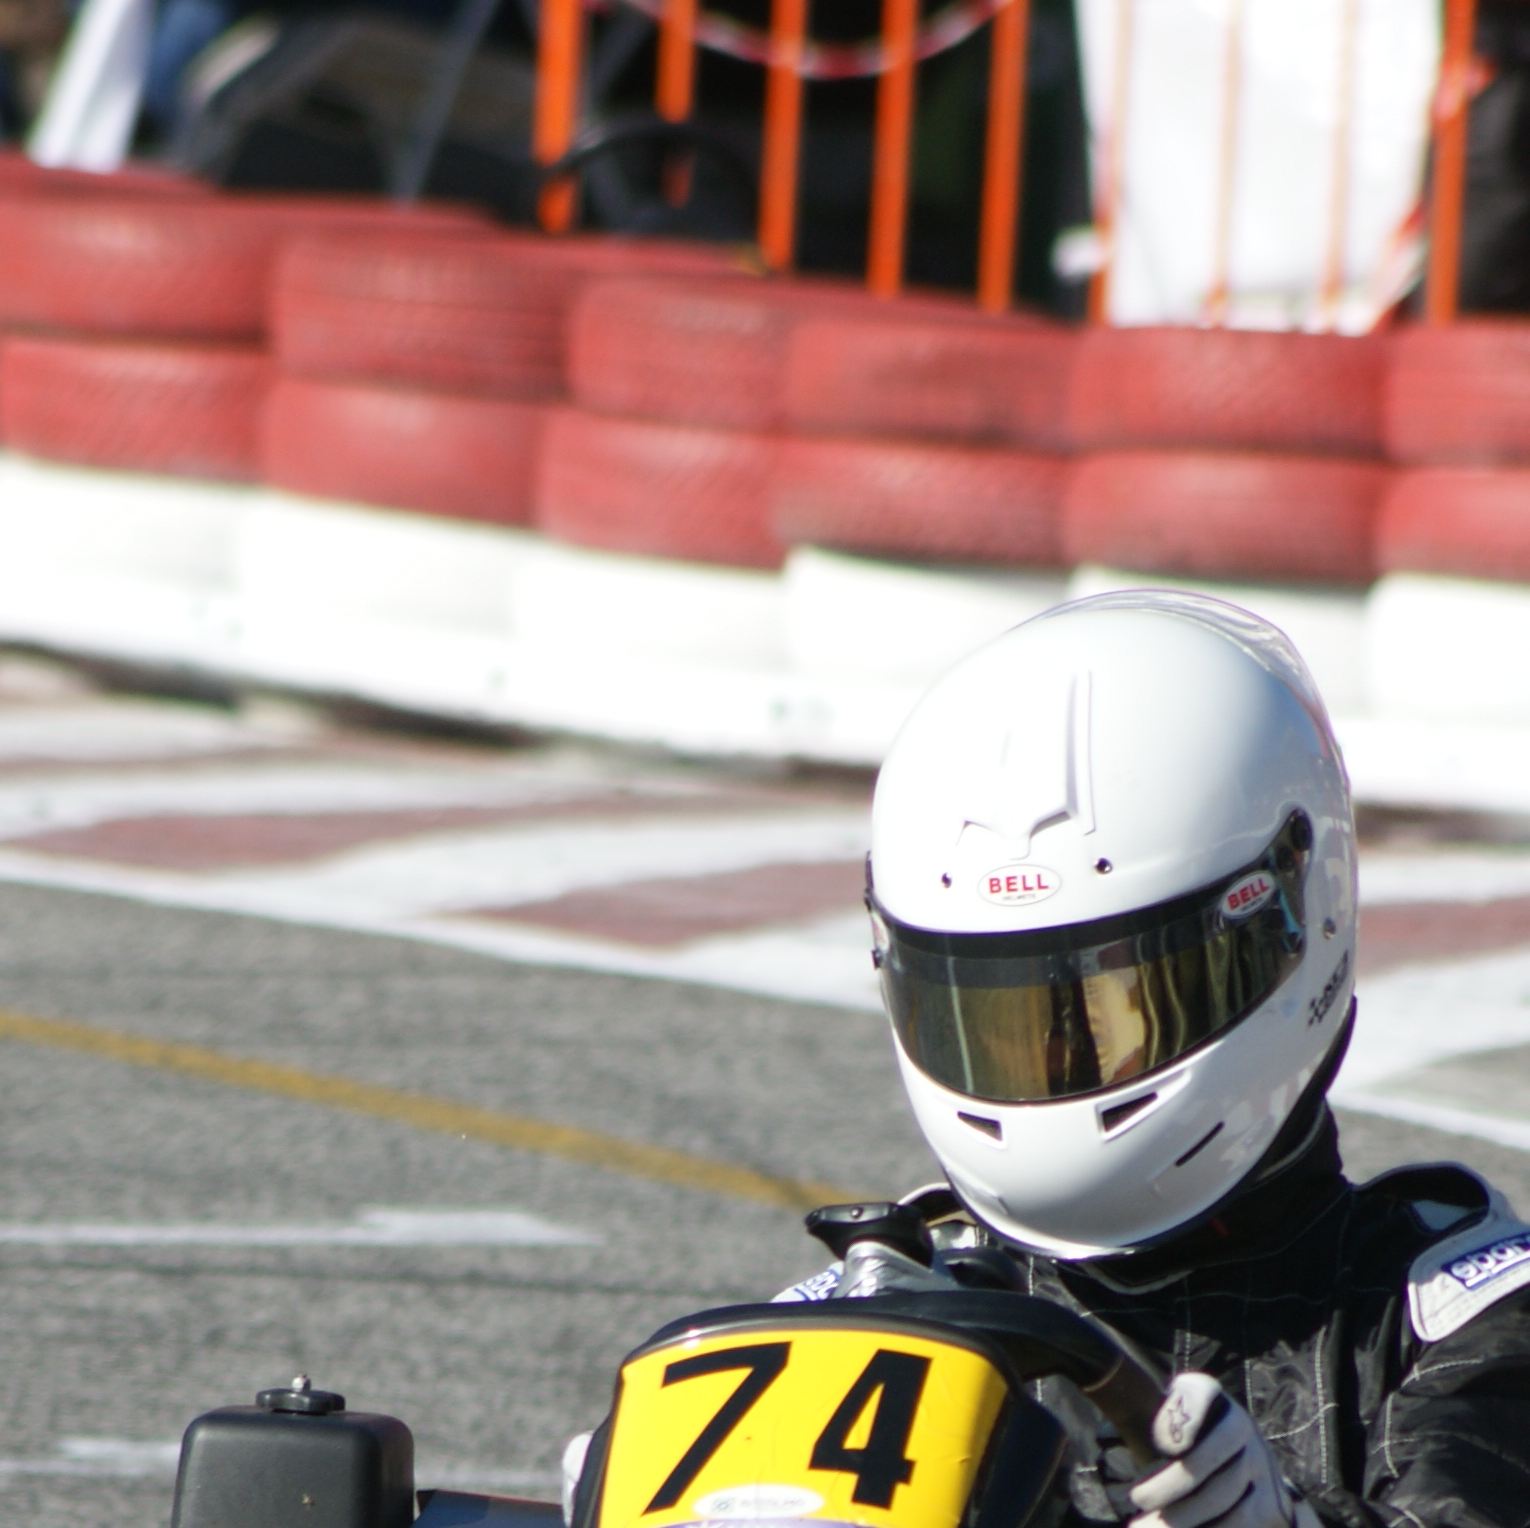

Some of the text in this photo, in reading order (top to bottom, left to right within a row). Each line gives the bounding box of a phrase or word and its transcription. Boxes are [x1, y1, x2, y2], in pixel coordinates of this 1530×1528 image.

[988, 873, 1050, 895] BELL
[1226, 877, 1270, 911] BELL
[641, 1341, 934, 1517] 74
